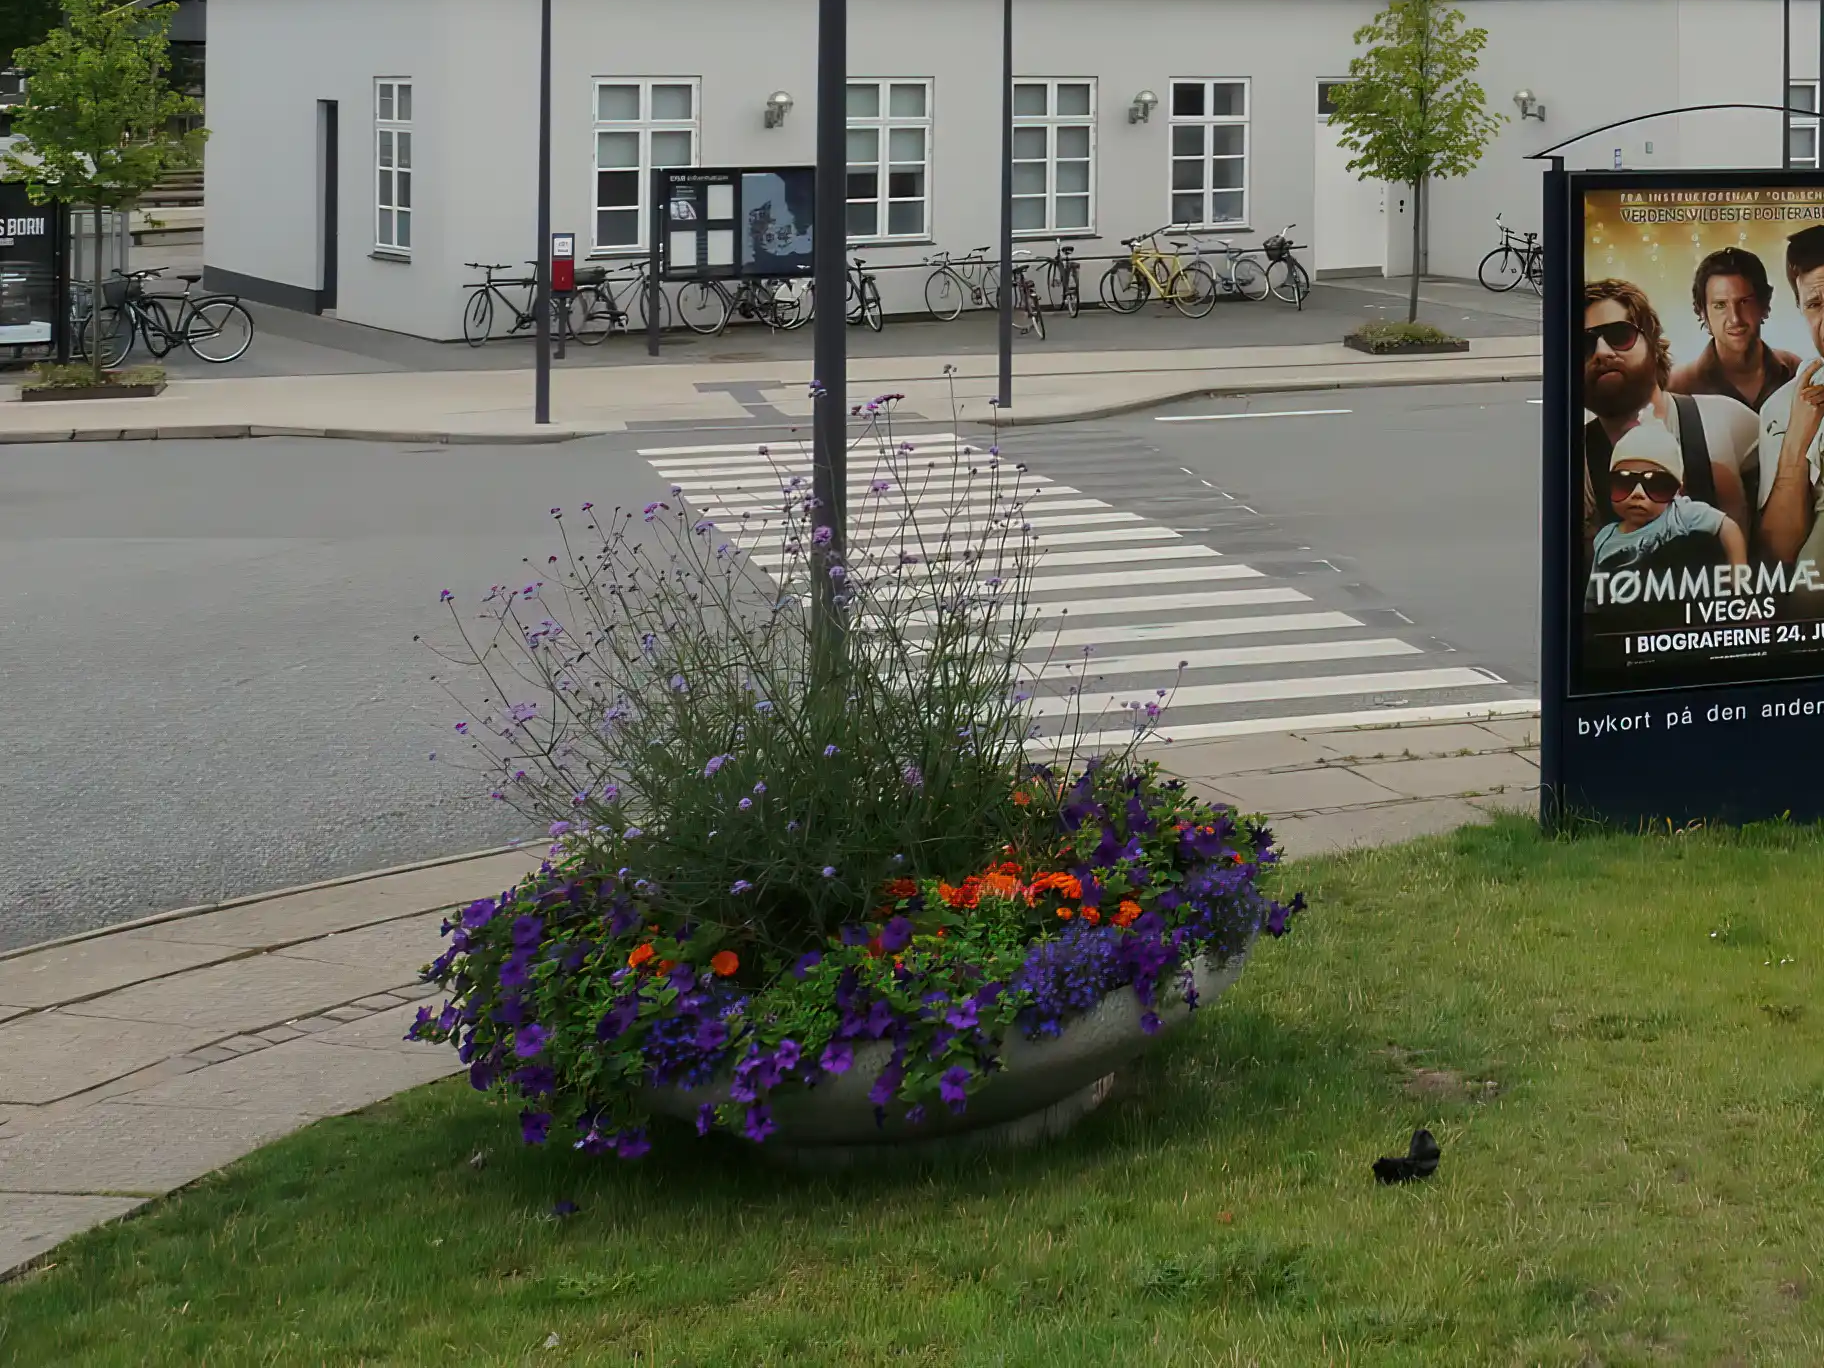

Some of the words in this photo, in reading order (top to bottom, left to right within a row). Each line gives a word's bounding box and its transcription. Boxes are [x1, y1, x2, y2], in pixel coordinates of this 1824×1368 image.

[1621, 207, 1684, 222] VERDENS
[1686, 207, 1751, 221] VILDESTE
[1685, 603, 1691, 624] I
[1699, 597, 1776, 622] VEGAS
[1625, 636, 1631, 654] I
[1637, 627, 1770, 653] BIOGRAFERNE
[1776, 624, 1806, 643] 24.
[1578, 712, 1651, 737] bykort
[1666, 706, 1693, 729] på
[1707, 704, 1747, 722] den
